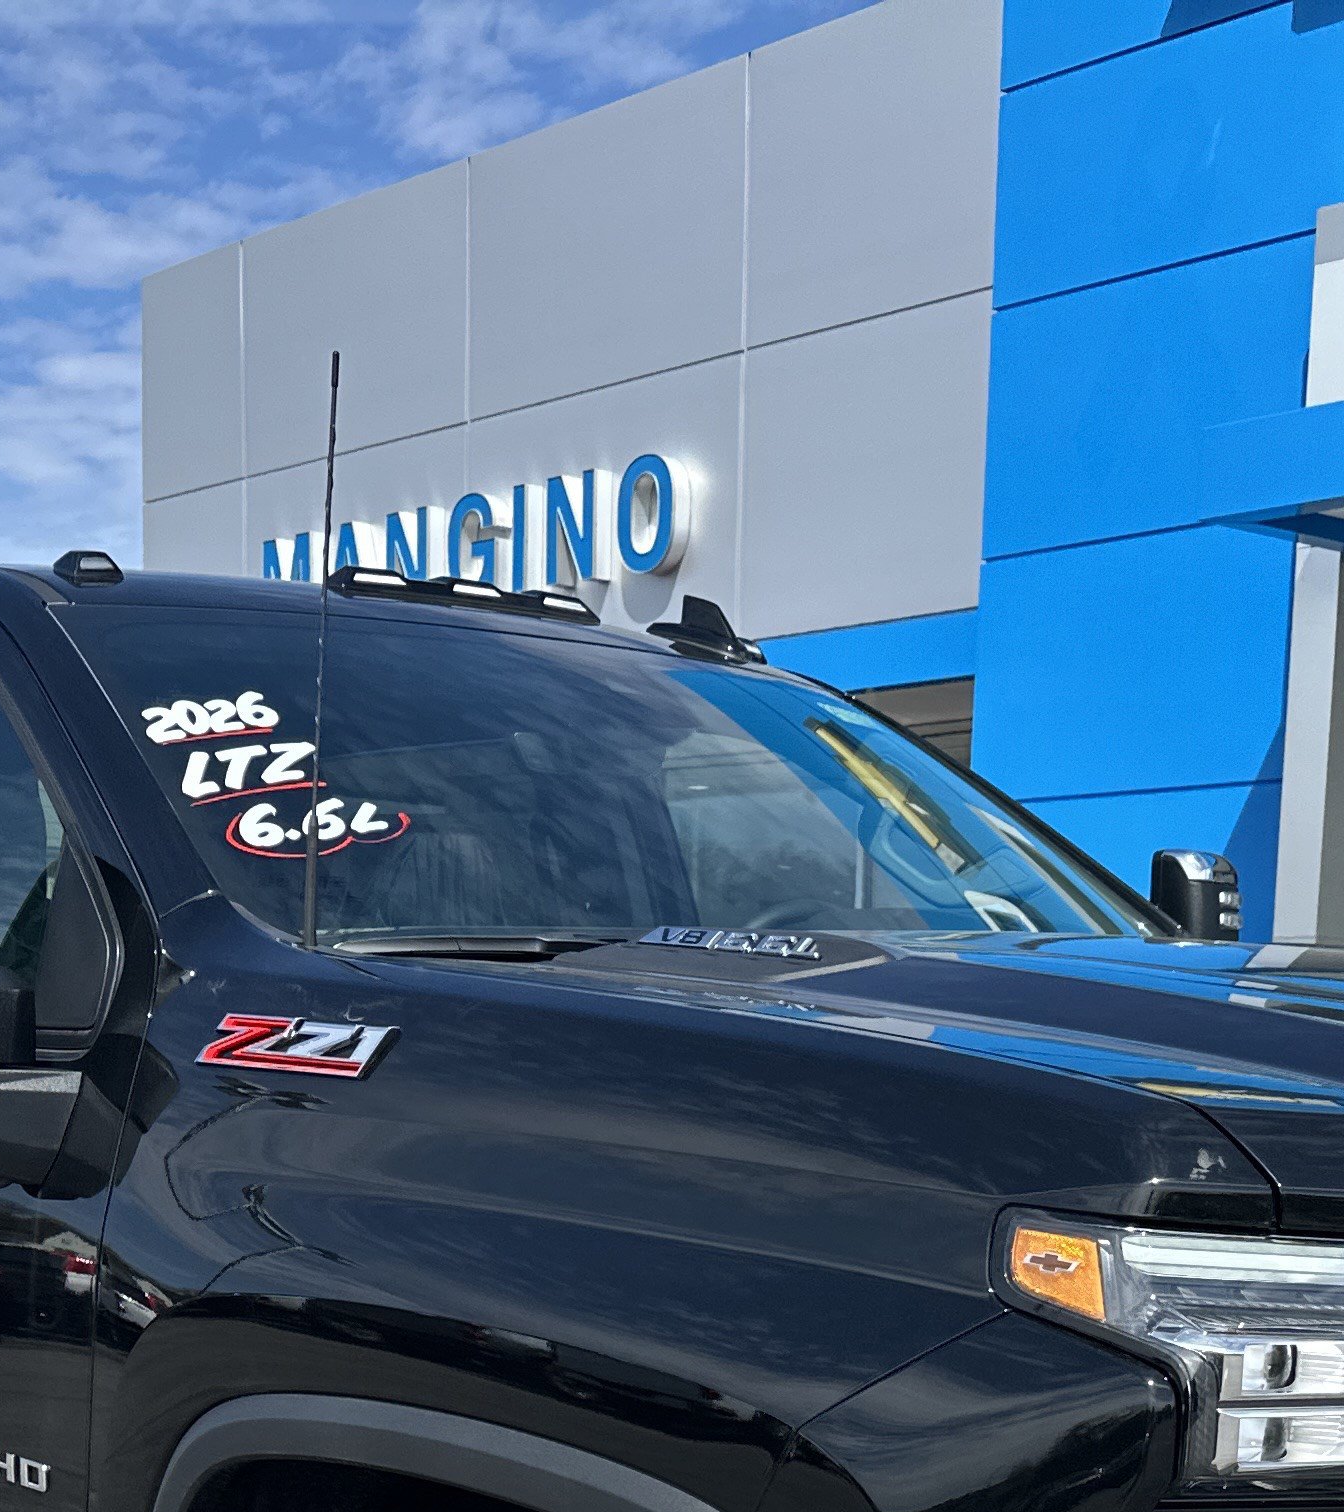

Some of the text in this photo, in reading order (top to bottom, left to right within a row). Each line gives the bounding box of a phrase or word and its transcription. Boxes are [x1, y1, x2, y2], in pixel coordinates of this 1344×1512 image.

[141, 691, 279, 744] 2026
[181, 741, 316, 798] LTZ
[195, 1013, 401, 1079] Z71
